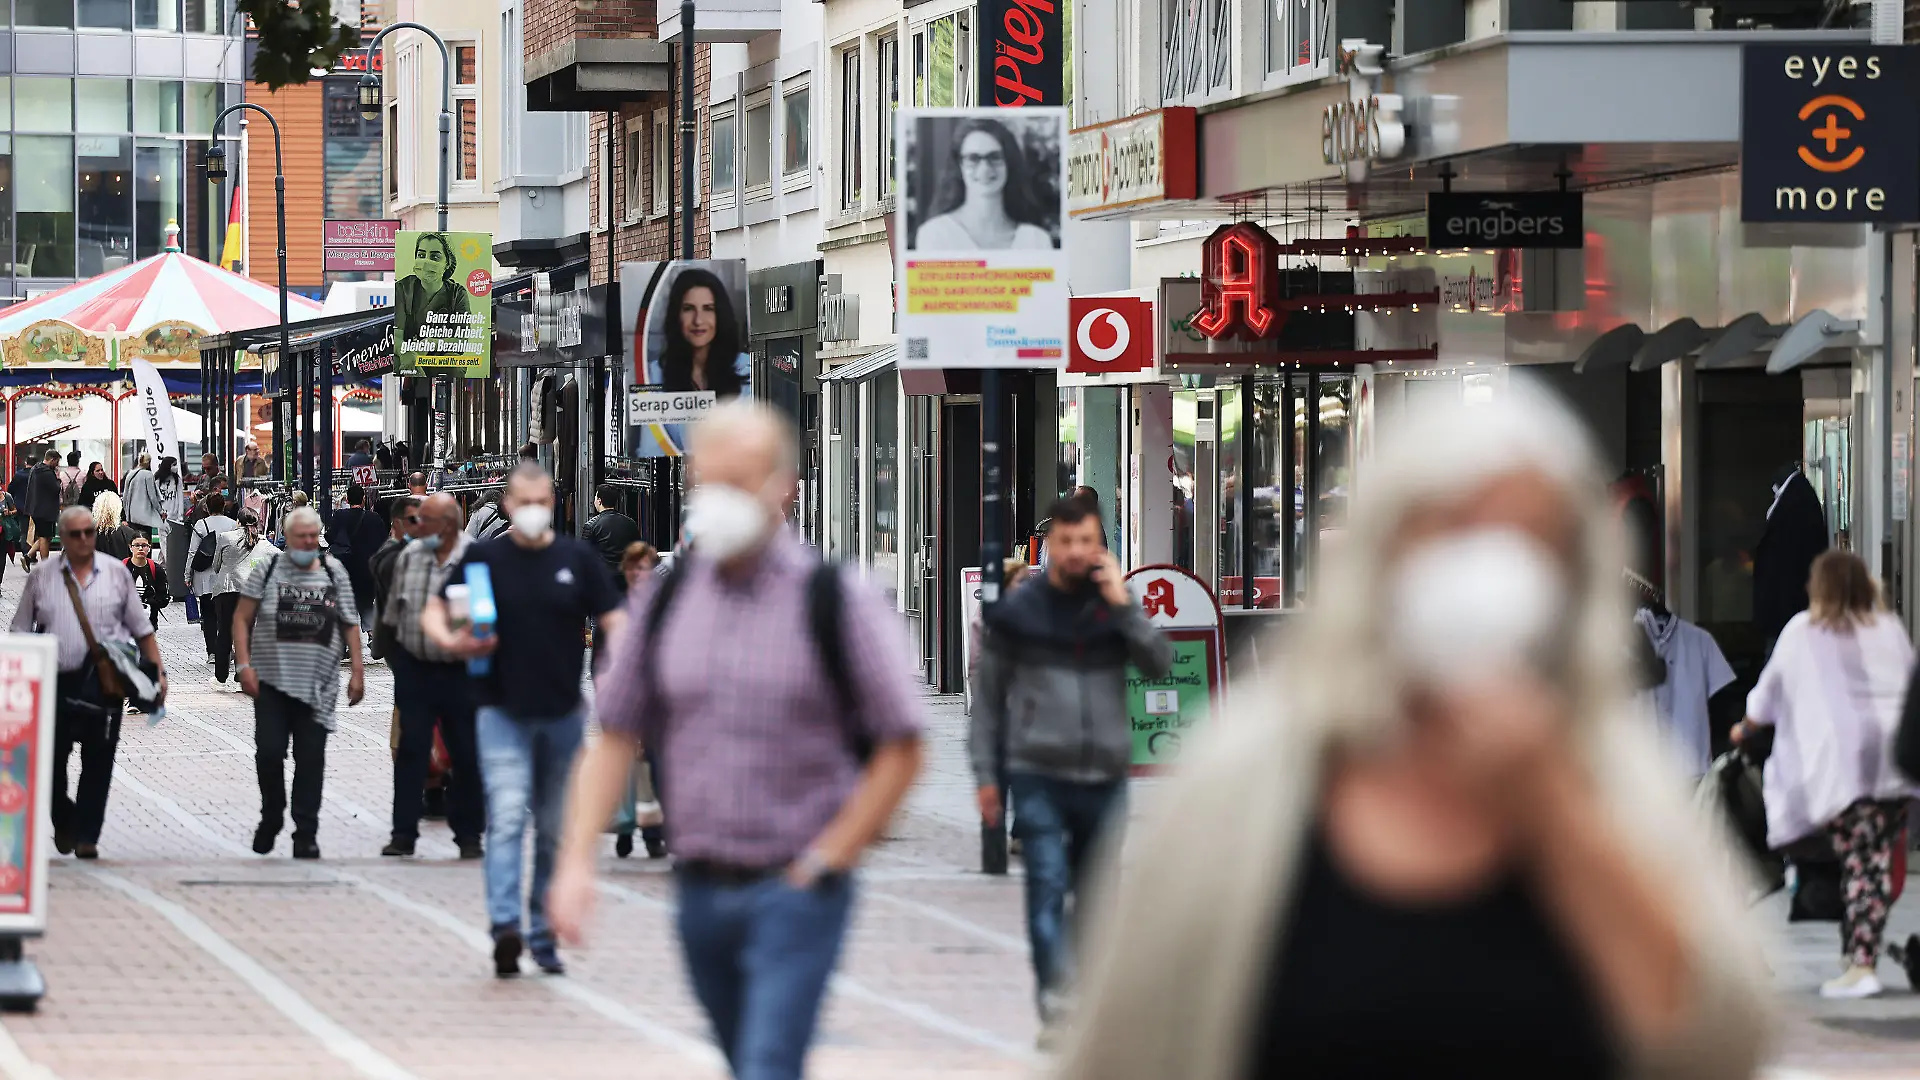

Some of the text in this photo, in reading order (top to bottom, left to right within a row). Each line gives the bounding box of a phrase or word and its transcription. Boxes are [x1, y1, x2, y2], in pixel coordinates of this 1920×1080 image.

[1784, 55, 1881, 87] eyes
[1111, 129, 1156, 204] Apotheke
[1776, 187, 1885, 211] more
[1446, 210, 1564, 240] engbers
[425, 310, 486, 324] Ganz einfach:
[419, 325, 485, 340] Gleiche Arbeit,
[400, 339, 485, 355] gleiche Bezahlung.
[631, 396, 714, 414] Serap Güler
[356, 467, 372, 483] 12
